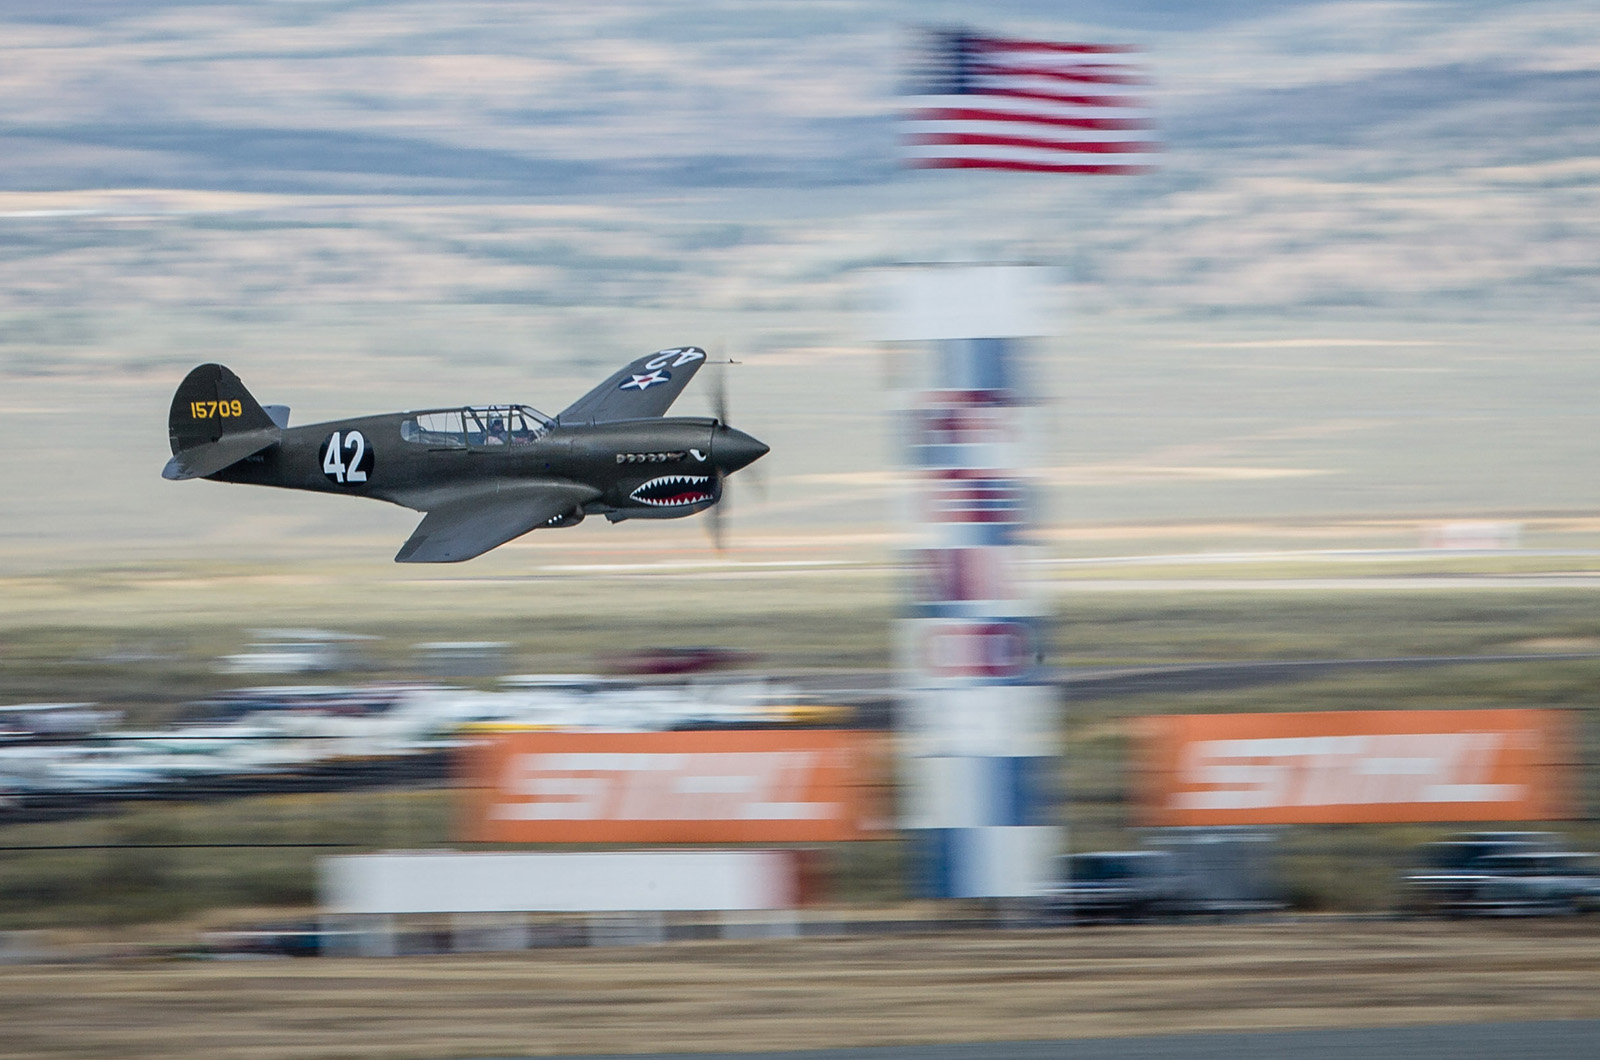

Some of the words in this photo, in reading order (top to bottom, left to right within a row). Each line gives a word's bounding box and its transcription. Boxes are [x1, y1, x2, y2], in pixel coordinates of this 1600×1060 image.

[645, 348, 704, 370] 42
[190, 399, 243, 419] 15709
[323, 430, 367, 483] 42
